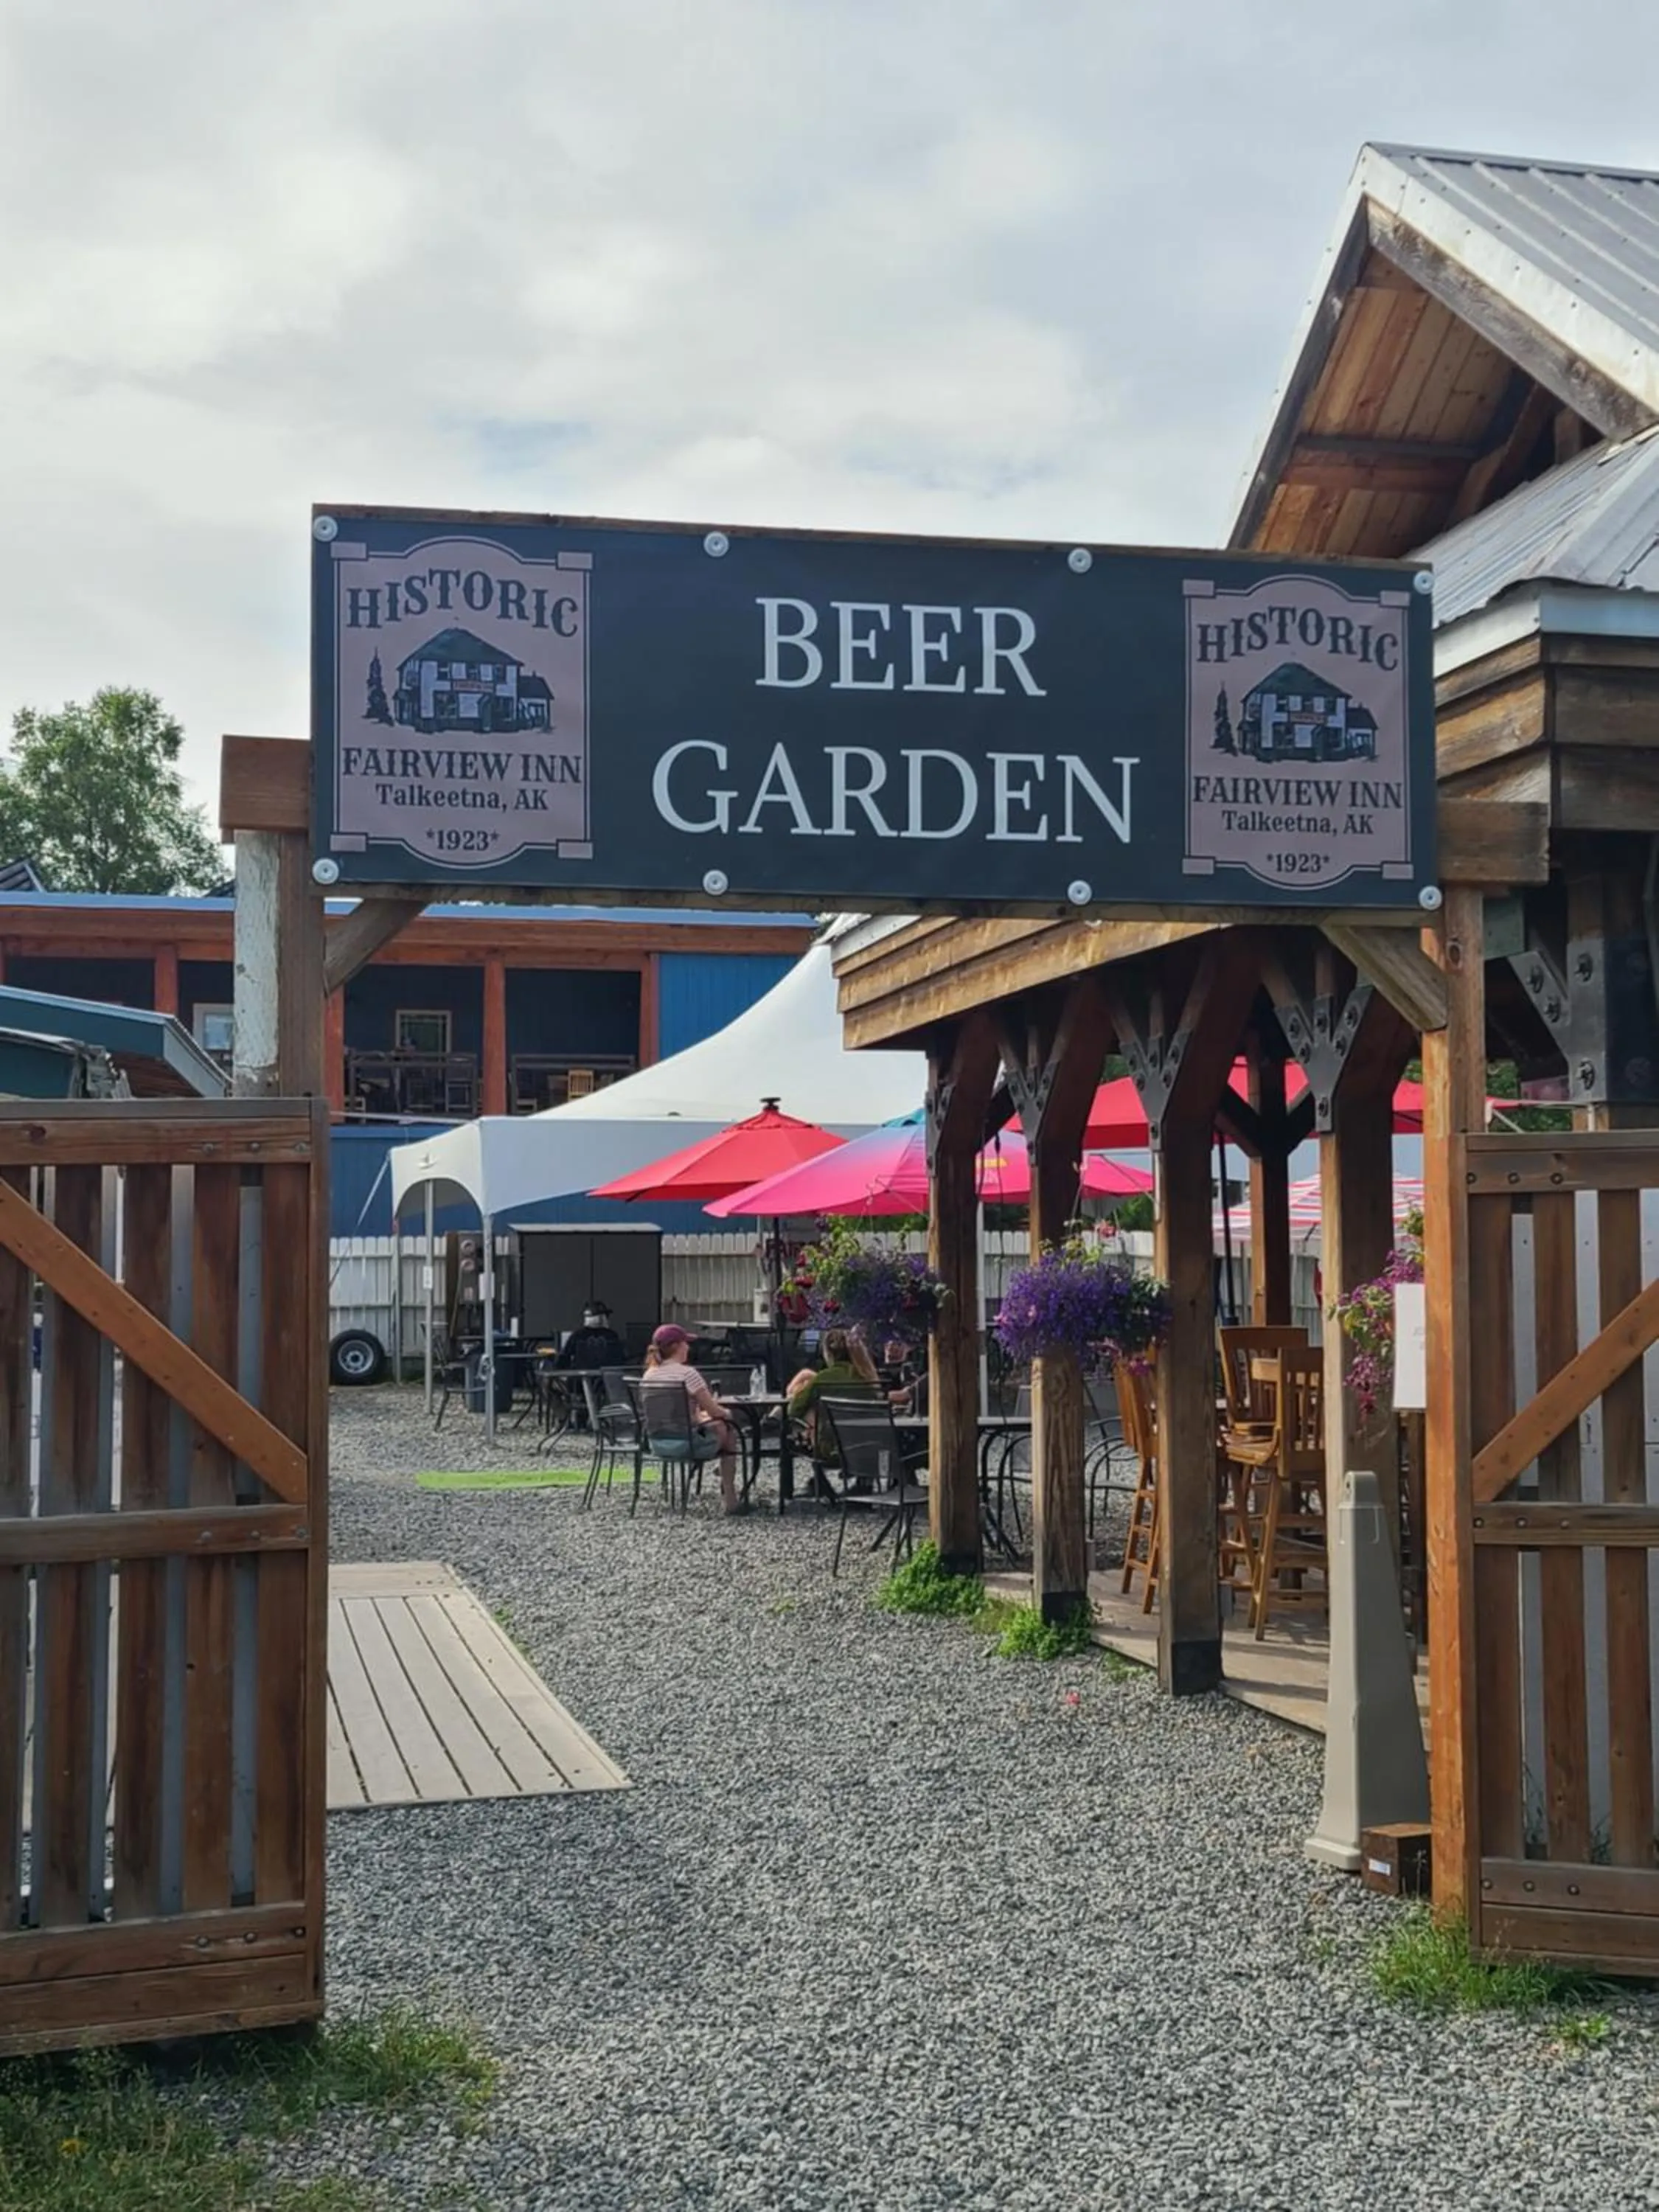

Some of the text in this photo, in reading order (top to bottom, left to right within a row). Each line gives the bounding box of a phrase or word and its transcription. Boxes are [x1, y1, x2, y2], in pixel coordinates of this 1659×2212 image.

[347, 568, 578, 636] HISTORIC
[756, 598, 1047, 696] BEER
[1197, 606, 1399, 671] HISTORIC
[343, 748, 582, 783] FAIRVIEW INN
[375, 784, 549, 813] Talkeetna, AK
[653, 740, 1141, 844] GARDEN
[1193, 776, 1403, 809] FAIRVIEW INN
[1222, 810, 1374, 837] Talkeetna, AK
